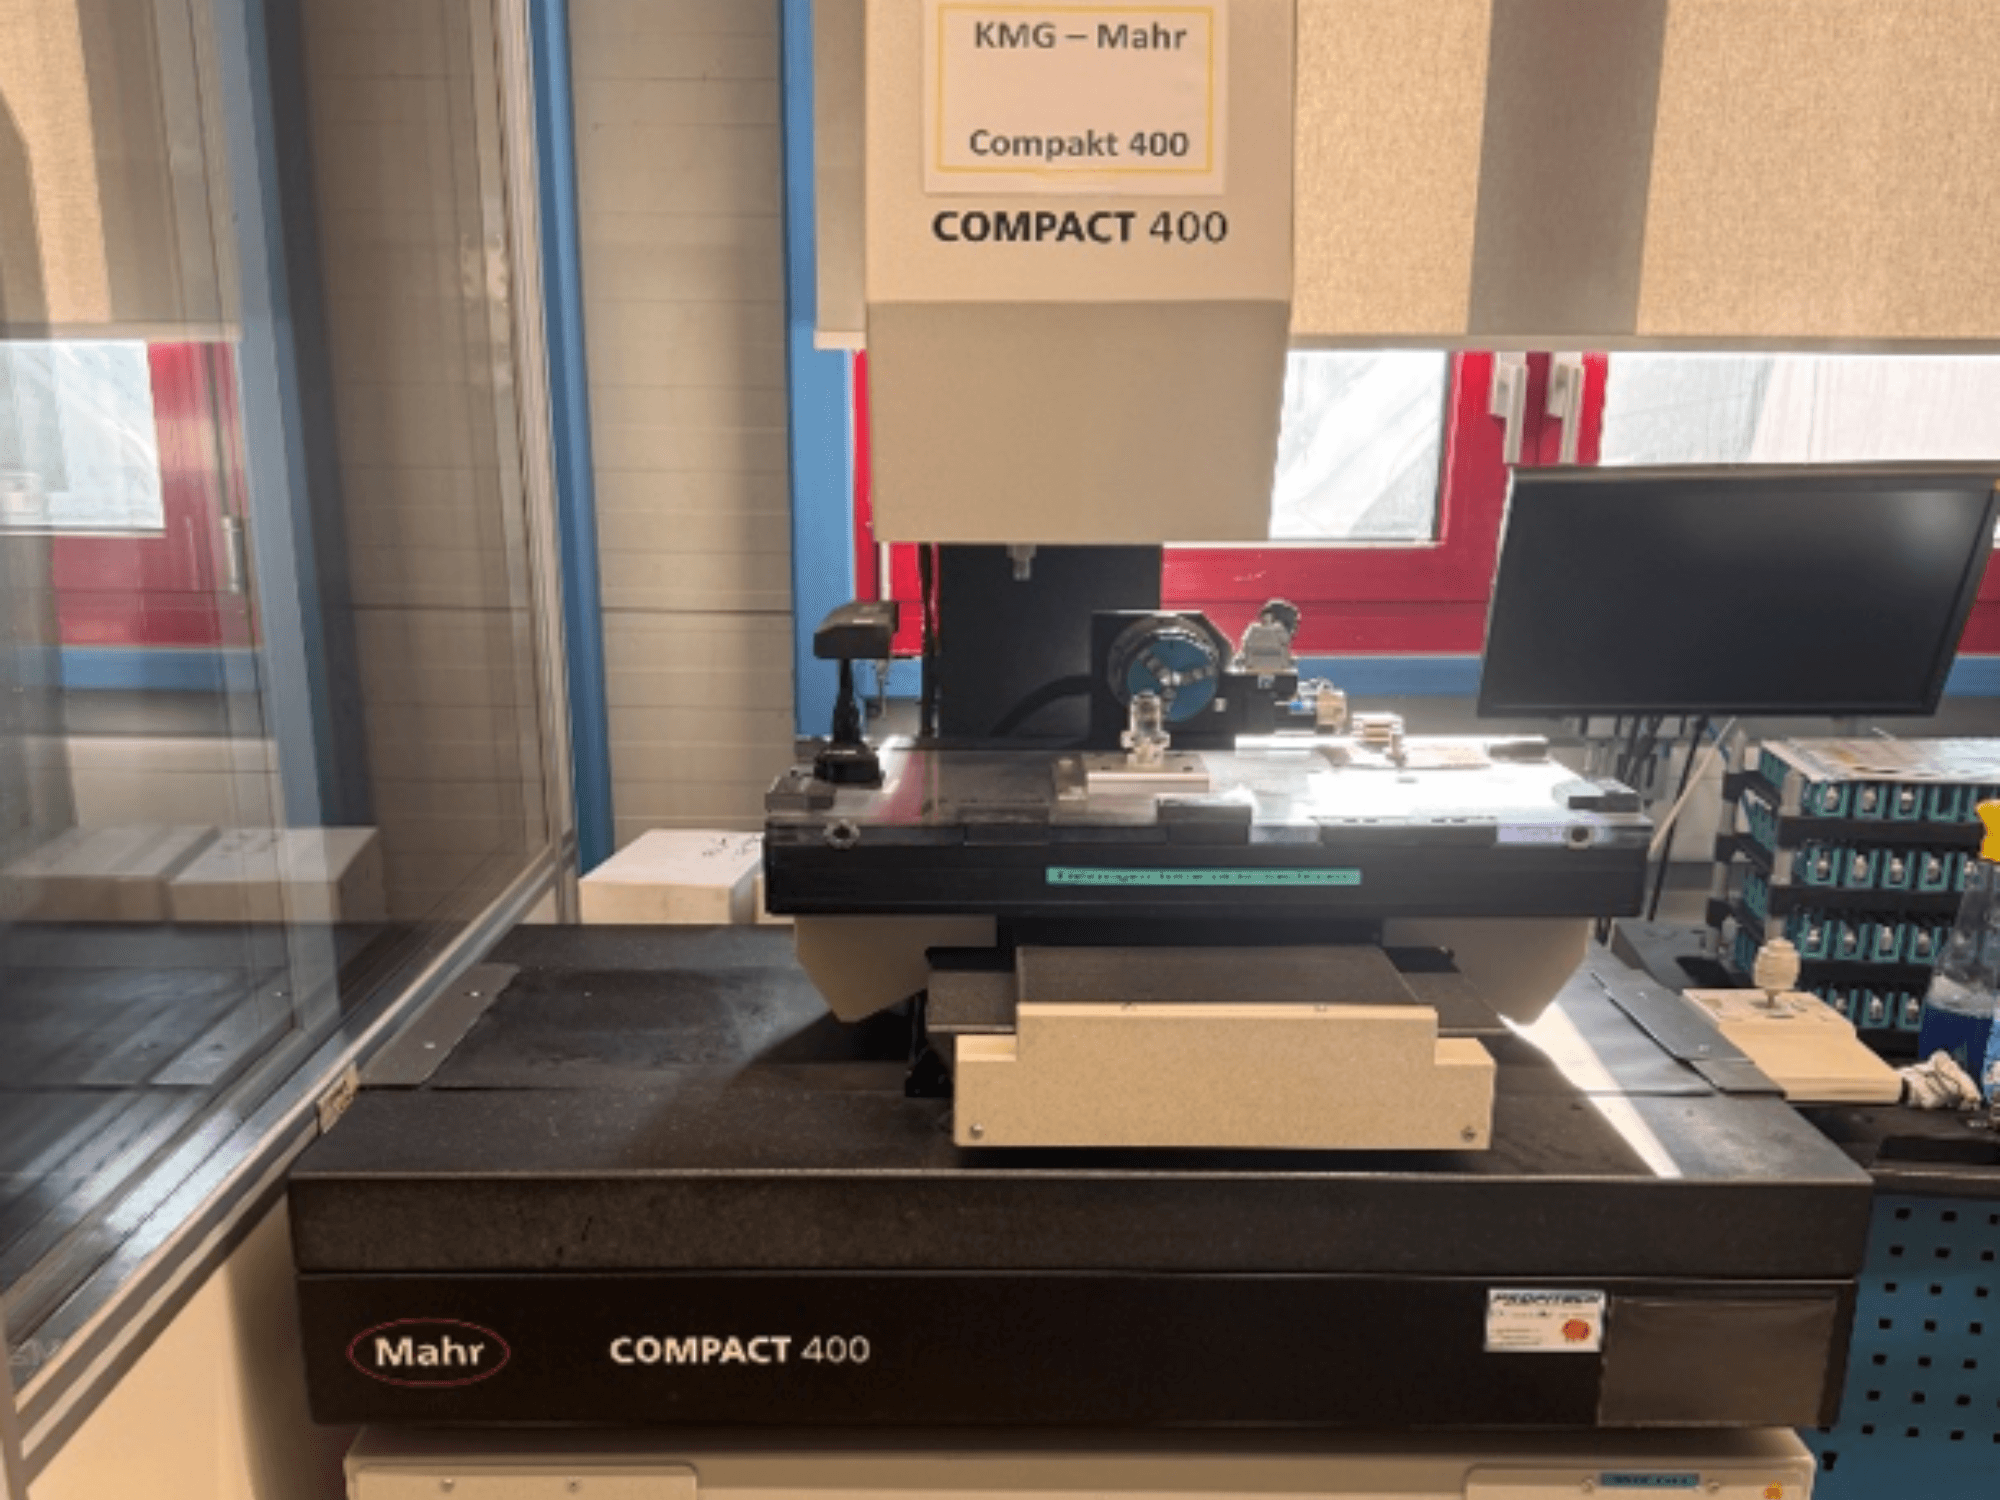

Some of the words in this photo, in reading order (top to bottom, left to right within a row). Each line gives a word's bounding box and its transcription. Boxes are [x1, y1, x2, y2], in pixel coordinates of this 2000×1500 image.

[975, 22, 1056, 49] KMG
[1097, 22, 1187, 49] Mahr
[969, 129, 1119, 162] Compakt
[1129, 131, 1190, 157] 400
[931, 211, 1136, 242] COMPACT
[1149, 210, 1229, 243] 400
[374, 1336, 486, 1367] Mahr
[609, 1336, 792, 1364] COMPACT
[801, 1336, 871, 1364] 400
